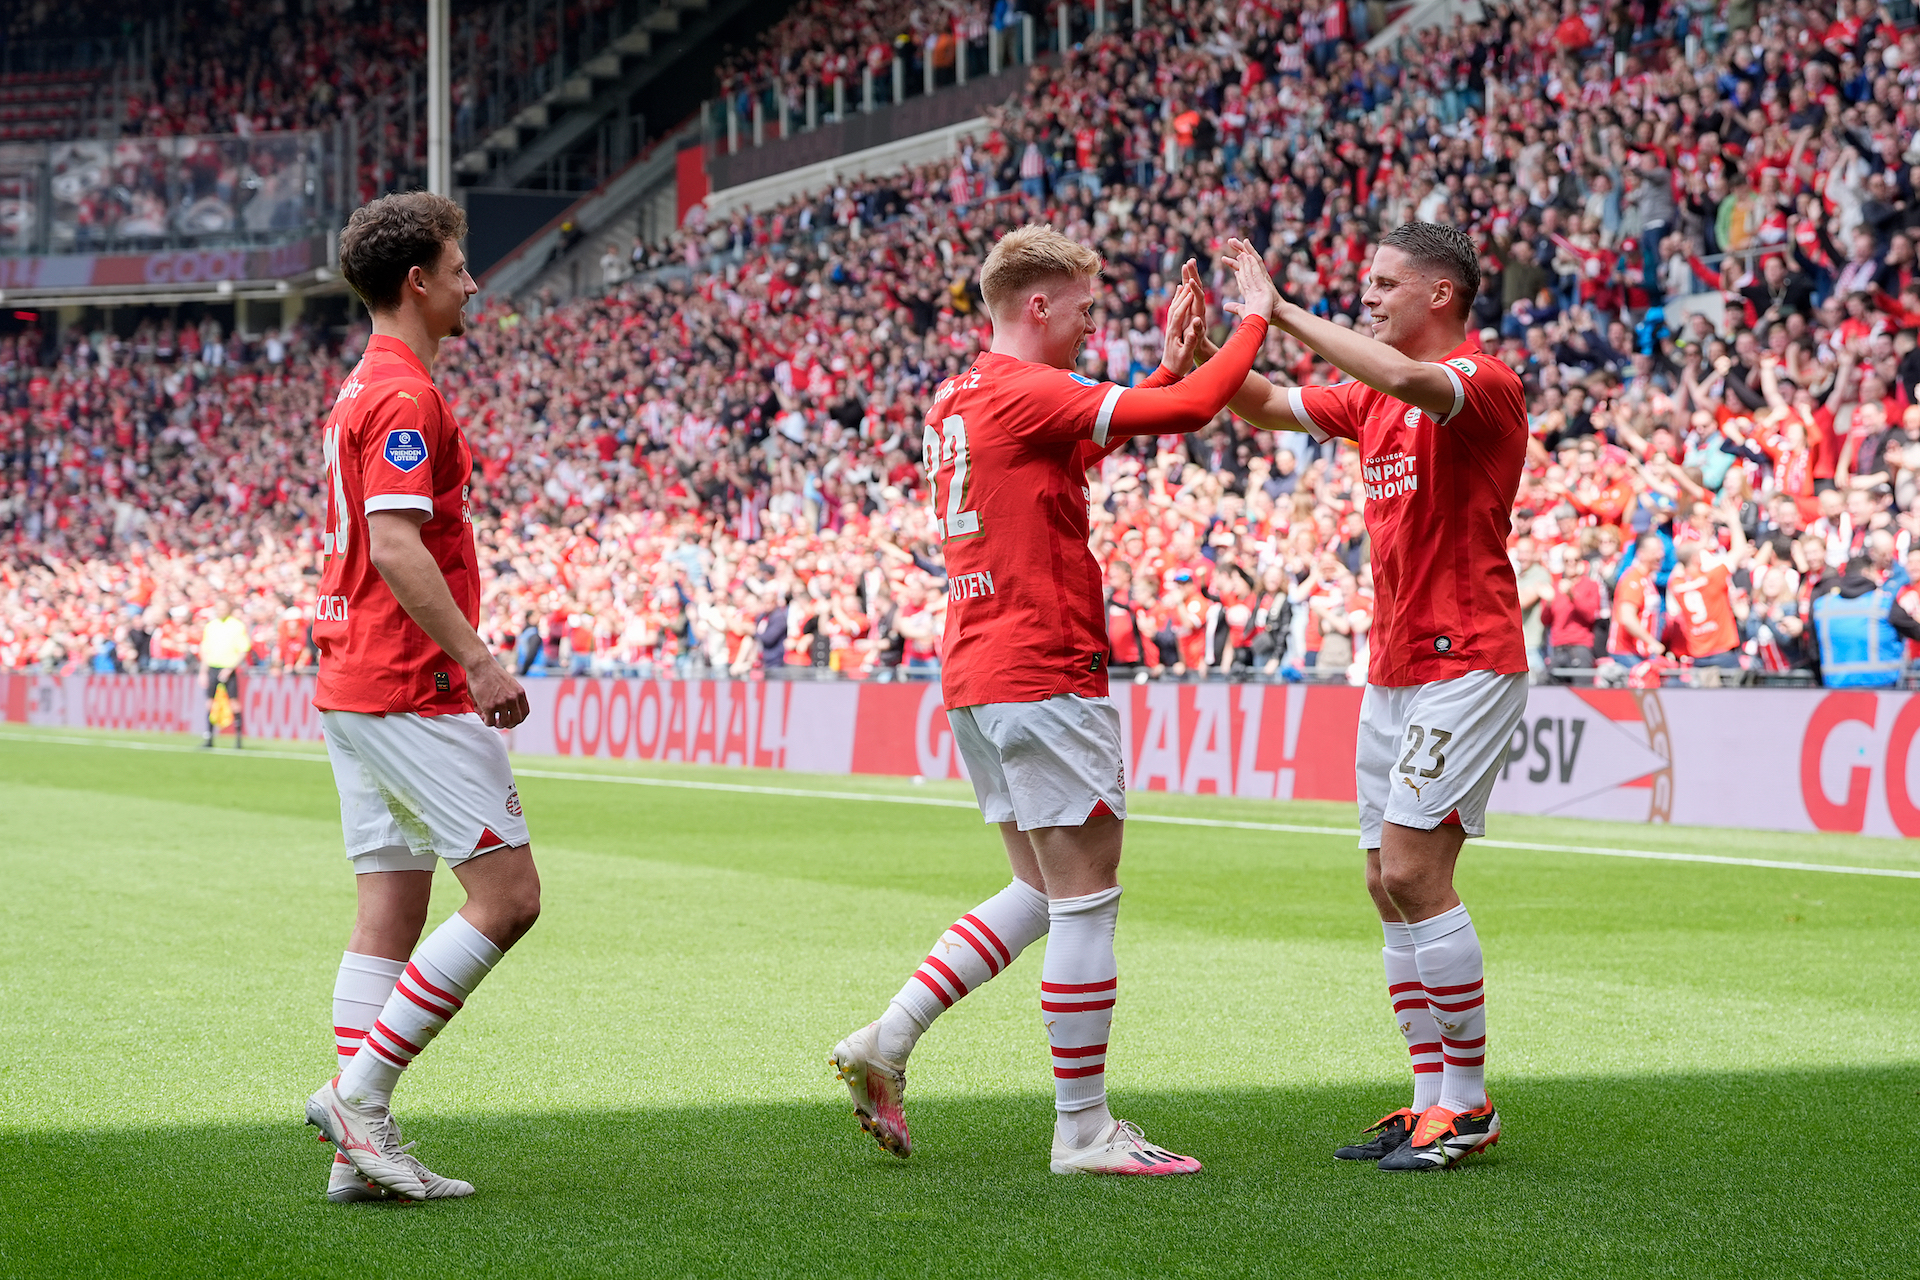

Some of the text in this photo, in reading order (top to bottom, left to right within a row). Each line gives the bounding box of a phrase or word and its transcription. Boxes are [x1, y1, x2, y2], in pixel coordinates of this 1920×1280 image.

[922, 413, 984, 543] 22
[1683, 590, 1707, 624] 9
[553, 678, 794, 770] GOOOAAAL!
[1399, 724, 1453, 779] 23
[1502, 717, 1586, 784] PSV
